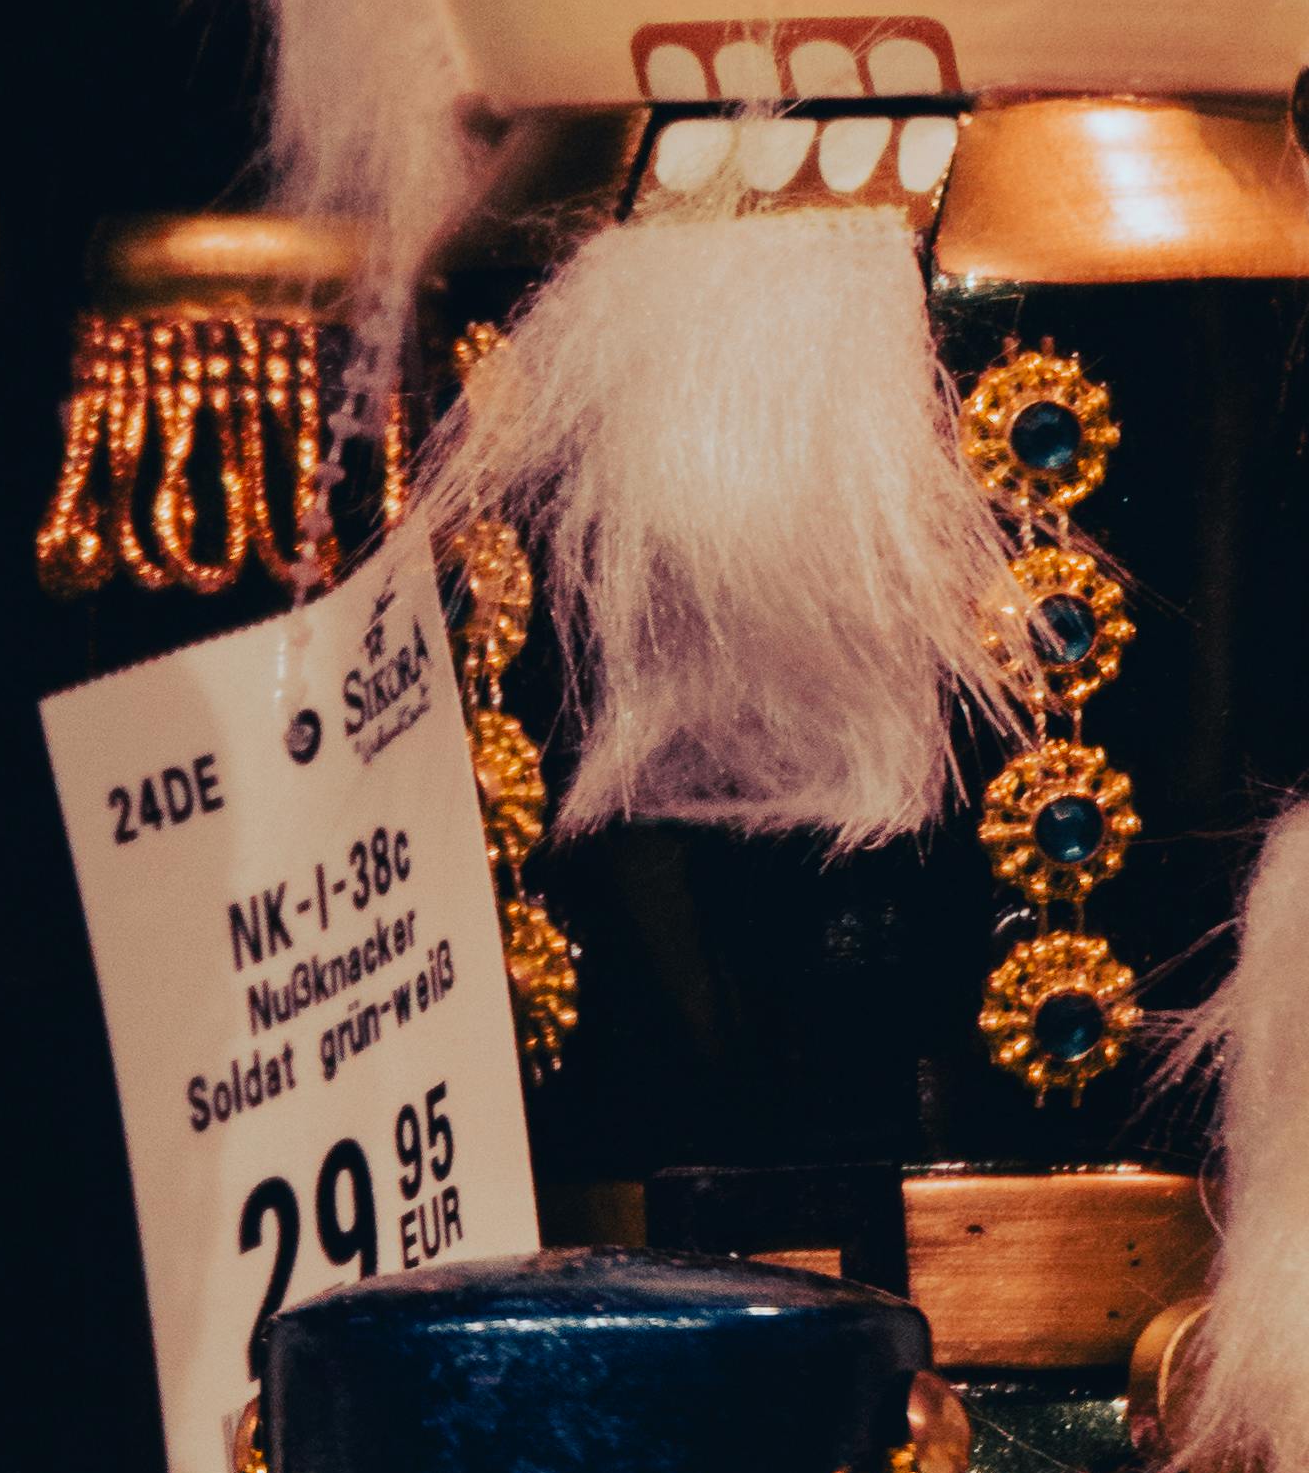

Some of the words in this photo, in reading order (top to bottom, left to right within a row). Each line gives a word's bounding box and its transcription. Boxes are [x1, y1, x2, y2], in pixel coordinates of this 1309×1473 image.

[108, 752, 225, 845] 24DE
[247, 909, 416, 1035] Nußknacker
[187, 1042, 296, 1134] Soldat
[320, 938, 456, 1082] grün-weiß
[239, 1137, 379, 1382] 29
[395, 1081, 454, 1201] 95
[400, 1185, 463, 1270] EUR
